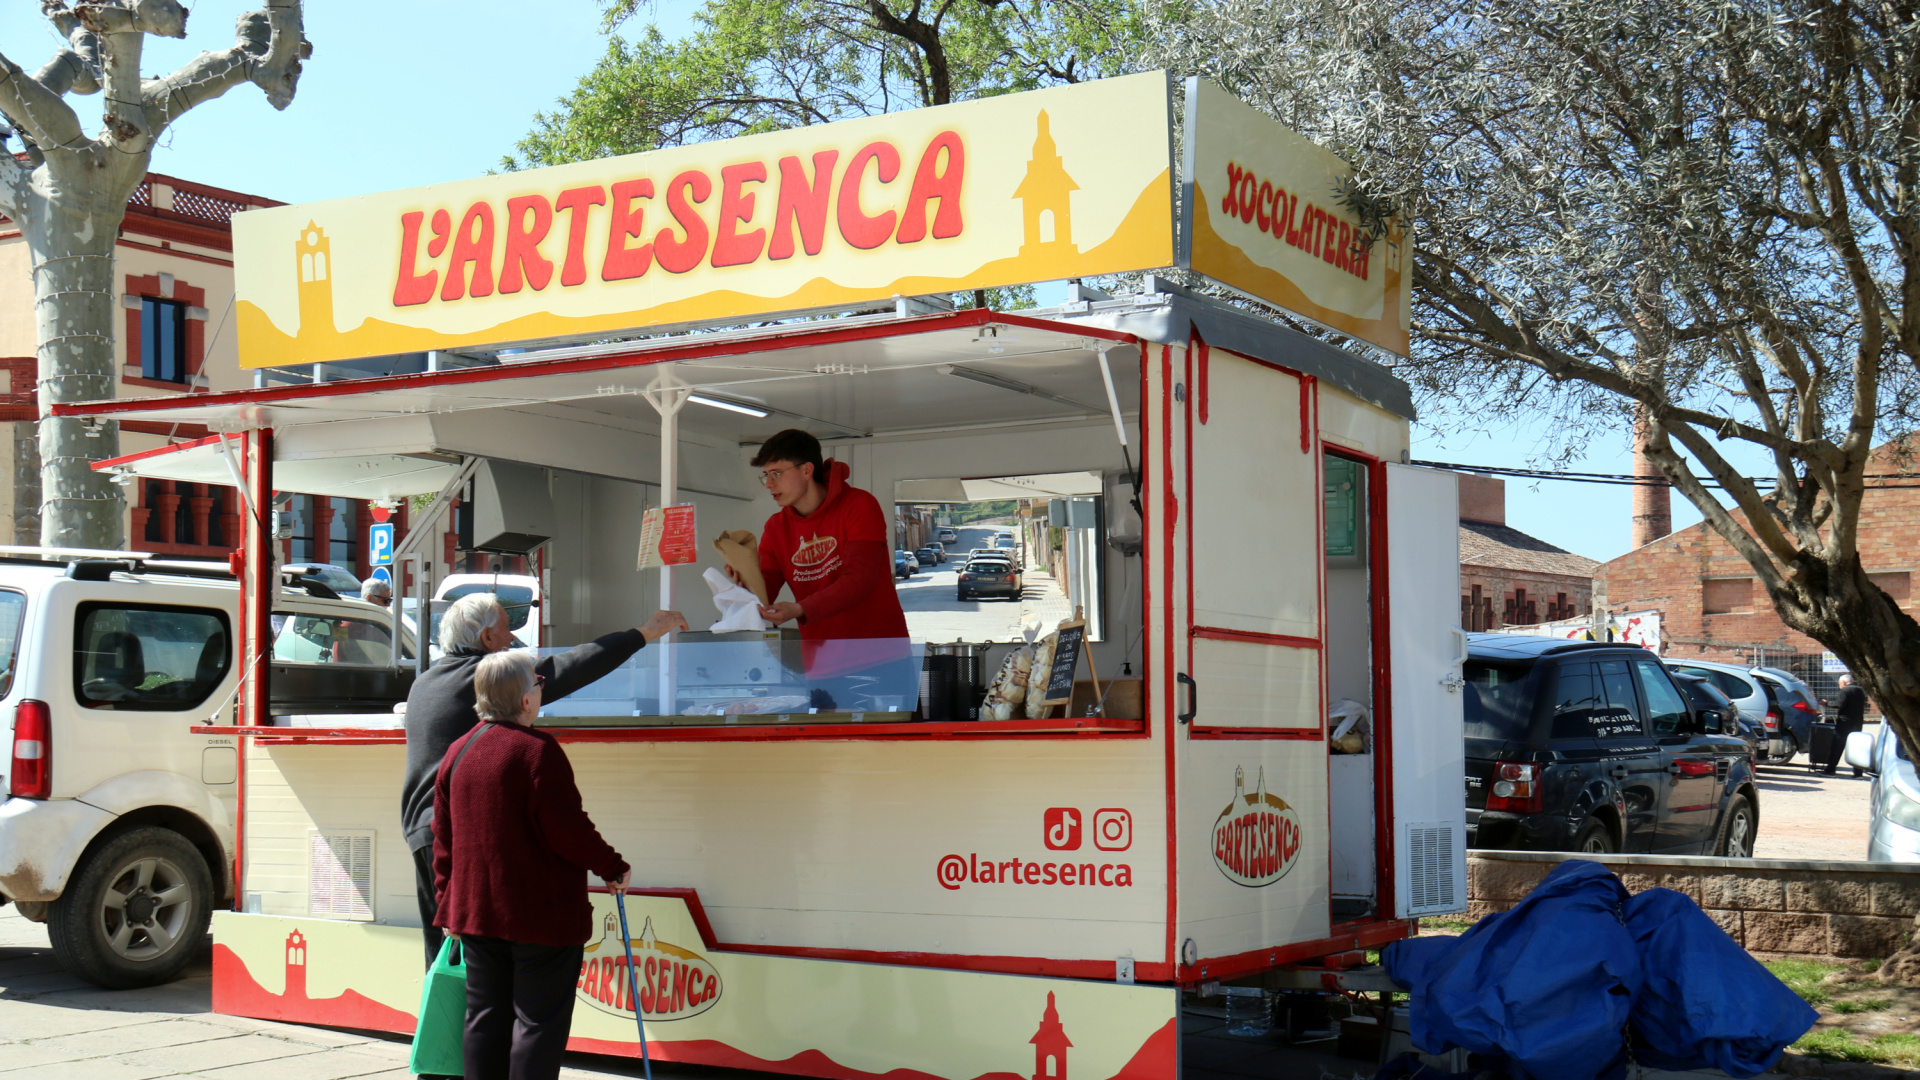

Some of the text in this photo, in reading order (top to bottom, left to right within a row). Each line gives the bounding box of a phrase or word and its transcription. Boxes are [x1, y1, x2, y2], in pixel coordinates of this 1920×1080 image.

[393, 130, 966, 307] L'ARTESENCA
[1222, 162, 1371, 281] XOCOLATERIA
[374, 530, 388, 550] P
[937, 853, 1133, 890] @lartesenca
[1216, 812, 1299, 878] L'ARTESENCA
[576, 955, 717, 1014] 'ARTESENCA
